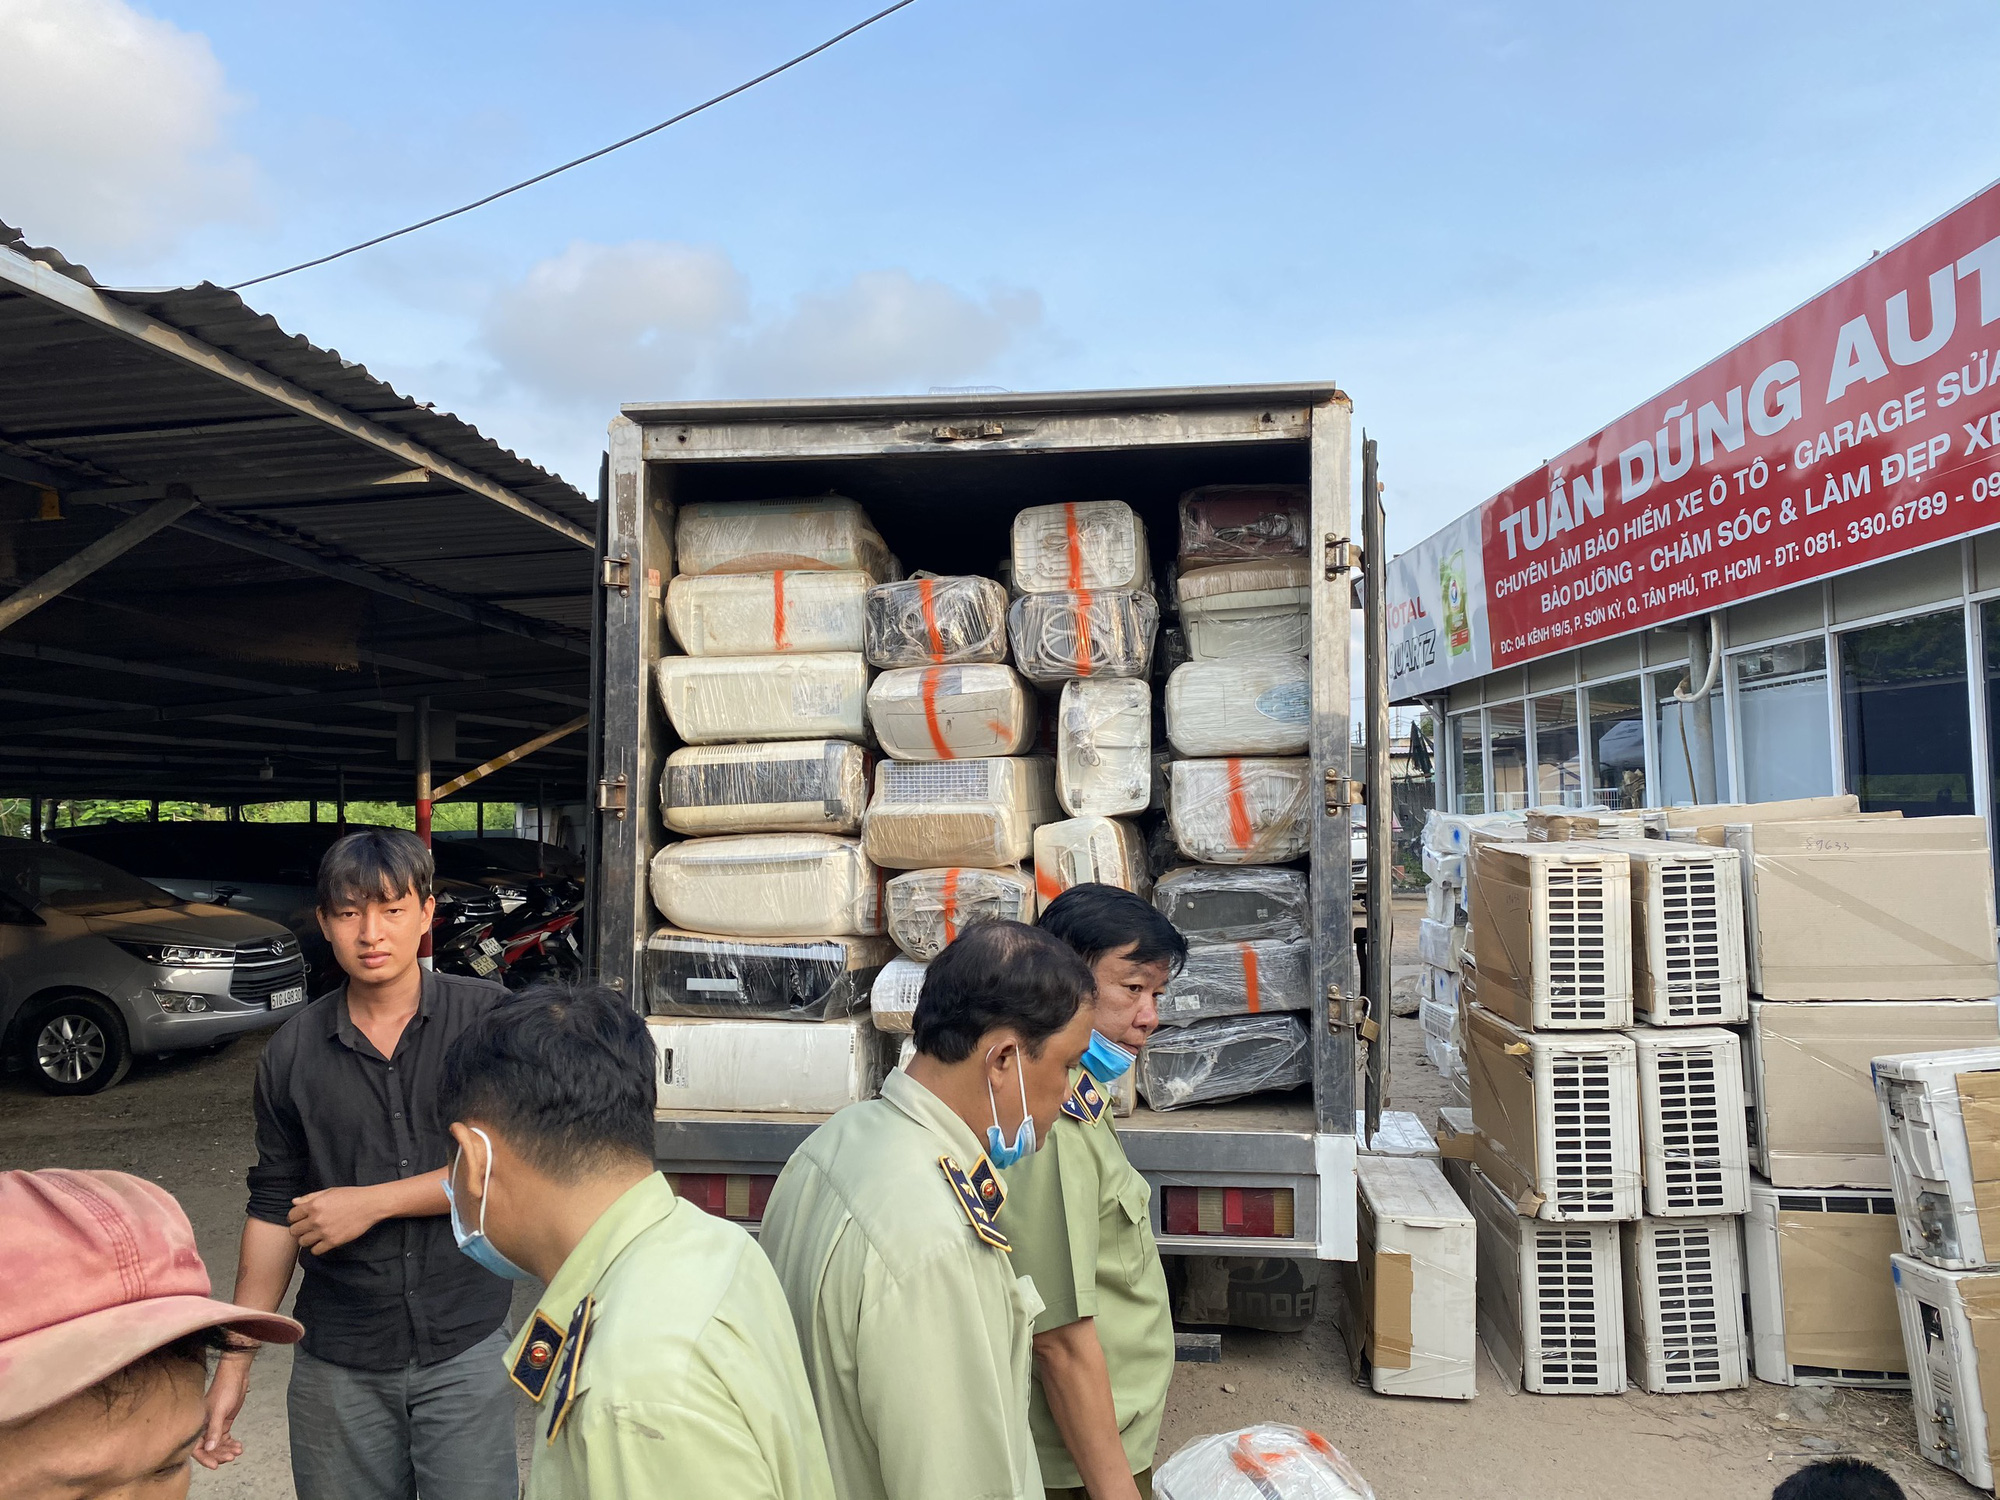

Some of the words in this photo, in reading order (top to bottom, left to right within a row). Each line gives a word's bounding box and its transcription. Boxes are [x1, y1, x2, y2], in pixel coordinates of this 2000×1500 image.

[1496, 560, 1548, 598] CHUYÊN
[1551, 545, 1581, 576] LÀM
[1585, 528, 1619, 560] BẢO
[1624, 503, 1671, 543] HIỂM
[1676, 488, 1704, 522] XE
[1709, 474, 1727, 506] Ô
[1733, 456, 1769, 495] TÔ
[1794, 386, 1926, 470] GARAGE
[1500, 466, 1604, 560] TUẤN
[1619, 360, 1802, 504] DŨNG
[1541, 585, 1571, 613] BẢO
[1574, 560, 1633, 601] DƯỠNG
[1650, 528, 1712, 572] CHĂM
[1717, 507, 1771, 547] SÓC
[1779, 497, 1798, 525] &
[1805, 464, 1871, 515] LÀM
[1881, 433, 1951, 487] ĐẸP
[1386, 596, 1427, 630] TOTAL
[1389, 628, 1436, 680] QUARTZ
[1501, 640, 1514, 654] ĐC:
[1515, 635, 1526, 650] 04
[1527, 625, 1550, 646] KÊNH
[1551, 620, 1573, 640] 19/5,
[1574, 616, 1583, 630] P.
[1585, 609, 1606, 628] SƠN
[1607, 600, 1625, 621] KỲ,
[1627, 597, 1640, 614] Q.
[1642, 586, 1666, 609] TÂN
[1669, 573, 1699, 601] PHÚ,
[1701, 569, 1721, 590] TP.
[1725, 555, 1761, 583] HCM
[1775, 542, 1800, 567] ĐT:
[1804, 529, 1841, 557] 081.
[1847, 491, 1948, 544] 330.6789
